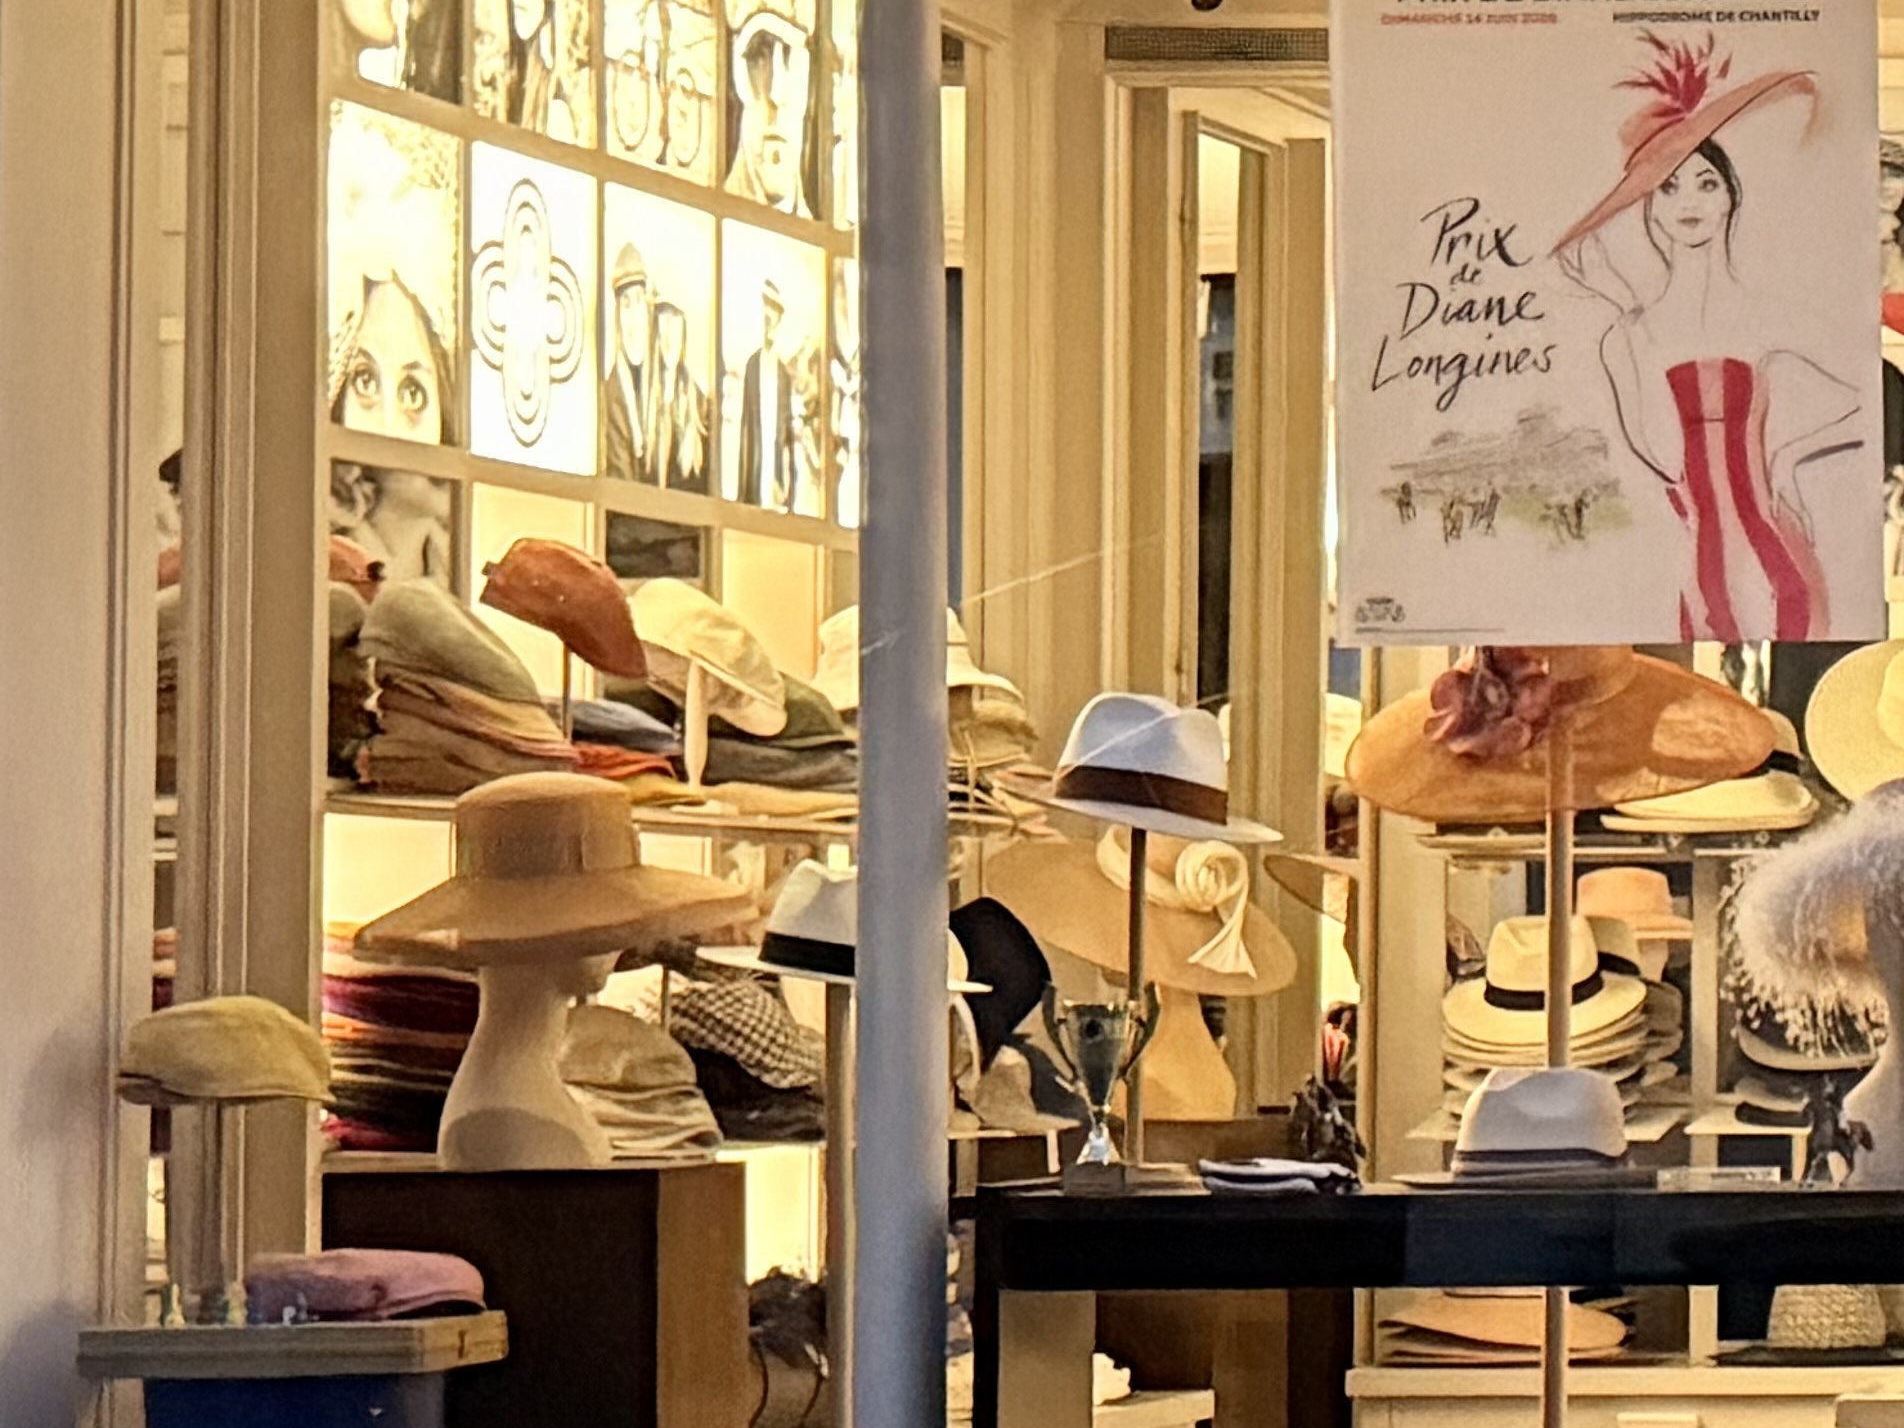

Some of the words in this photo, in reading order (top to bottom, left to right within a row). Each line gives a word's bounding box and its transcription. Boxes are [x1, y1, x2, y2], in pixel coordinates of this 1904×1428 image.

[1715, 10, 1735, 22] DE
[1739, 9, 1821, 22] CHANTILLY
[1420, 197, 1534, 268] Prix
[1450, 262, 1484, 287] de
[1396, 281, 1546, 340] Diane
[1372, 332, 1558, 412] Longines
